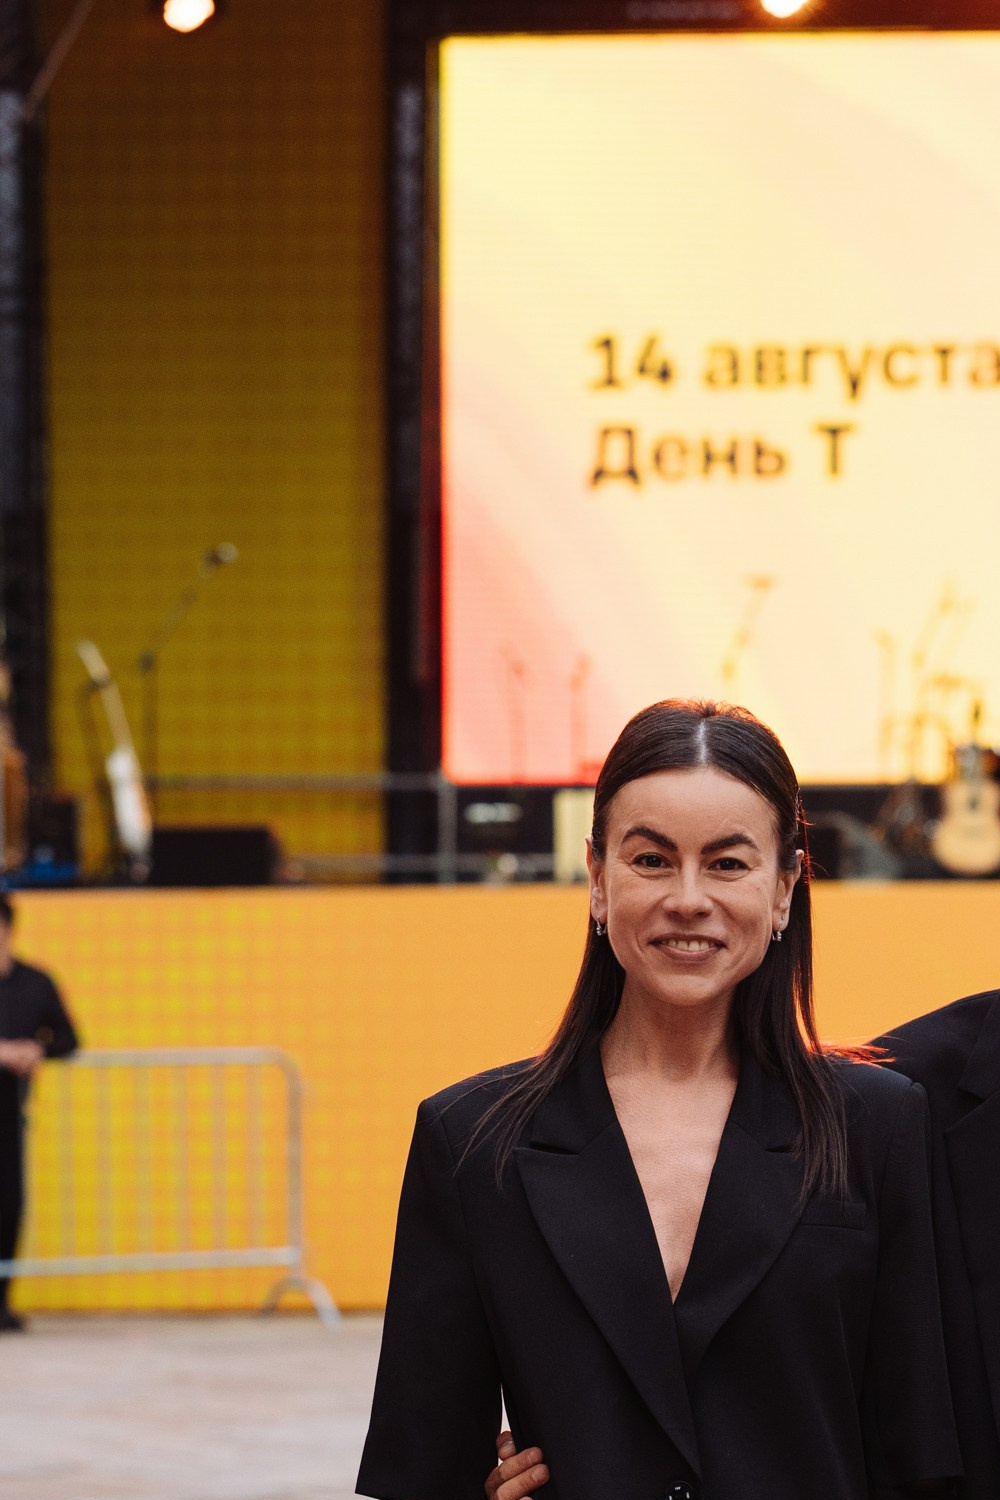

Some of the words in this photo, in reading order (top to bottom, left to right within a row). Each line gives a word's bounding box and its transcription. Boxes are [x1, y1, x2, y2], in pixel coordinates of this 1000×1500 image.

[589, 332, 677, 391] 14
[588, 423, 789, 490] День
[811, 420, 857, 480] Т
